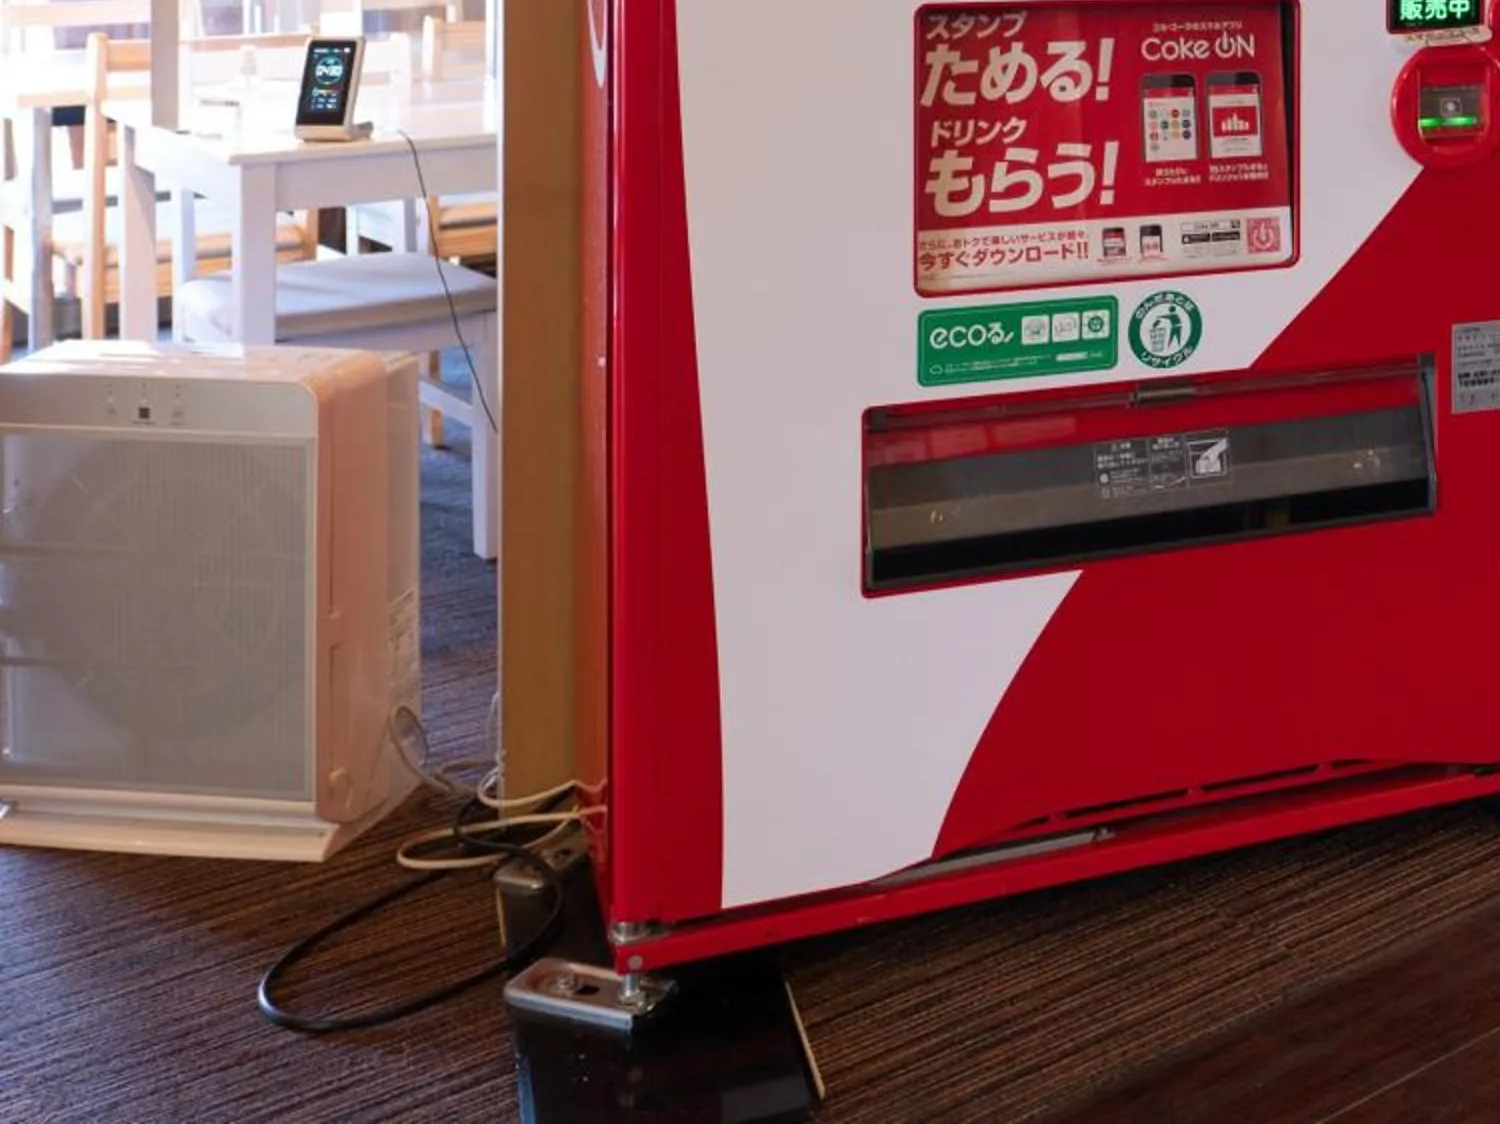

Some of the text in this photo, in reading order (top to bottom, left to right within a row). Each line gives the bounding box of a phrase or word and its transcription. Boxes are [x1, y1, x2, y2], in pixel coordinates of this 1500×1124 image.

[925, 10, 1028, 40] スタンプ
[1141, 30, 1255, 61] Coke ON
[919, 37, 1114, 107] ためる!
[930, 117, 1027, 149] ドリンク
[924, 140, 1120, 218] もらう!
[919, 242, 1089, 271] 今すぐダウンロード!!
